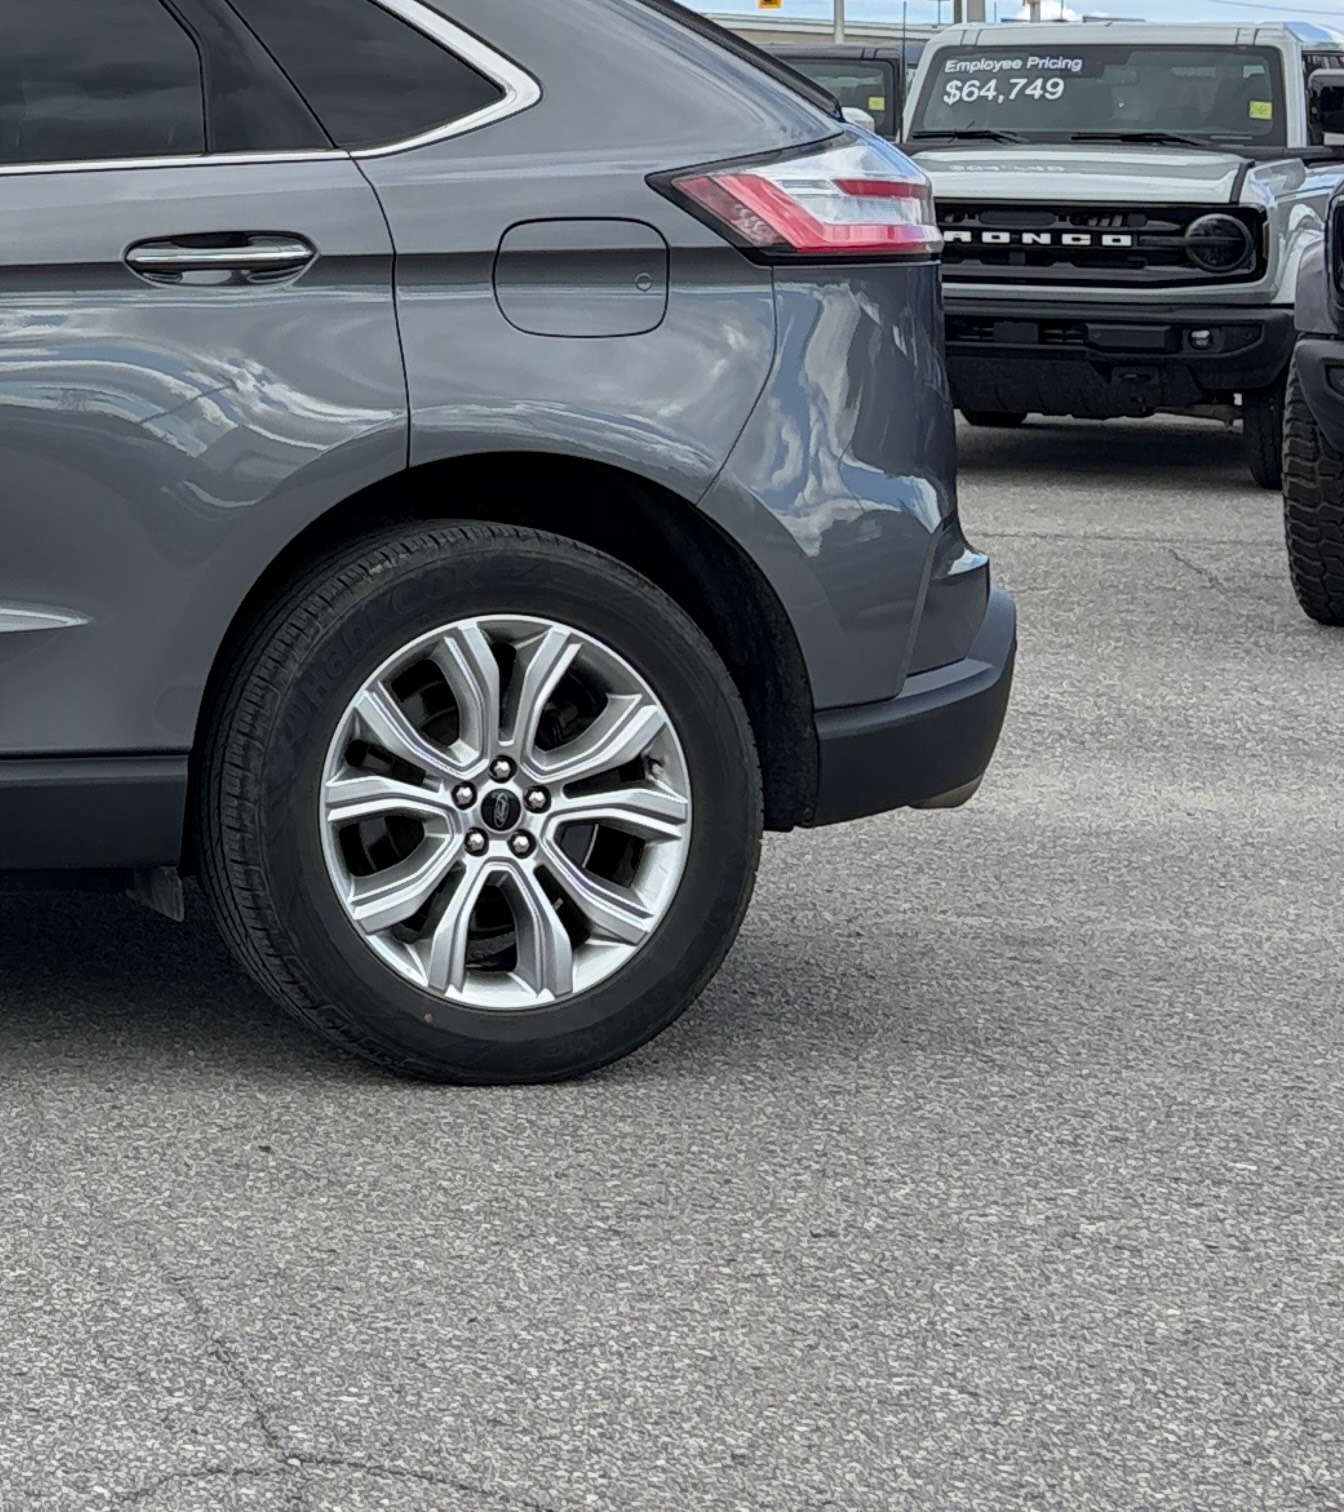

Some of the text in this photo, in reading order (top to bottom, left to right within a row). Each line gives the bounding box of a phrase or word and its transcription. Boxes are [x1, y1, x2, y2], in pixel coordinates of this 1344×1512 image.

[944, 56, 1082, 74] Employee Pricing
[943, 77, 1064, 105] $64,749
[943, 230, 1132, 247] RONCO
